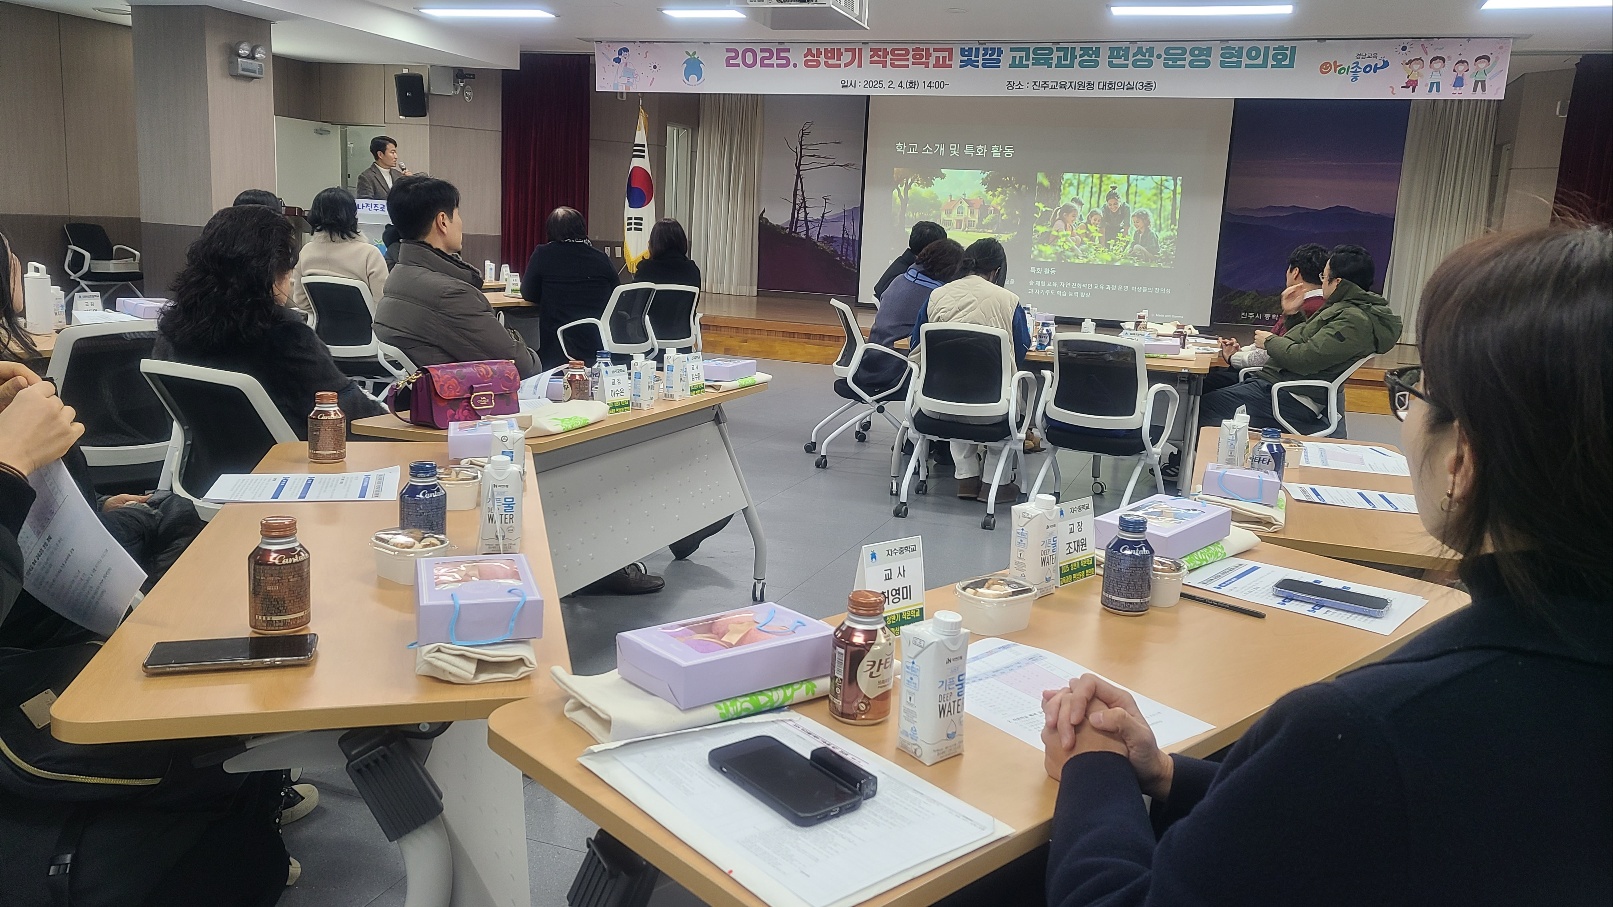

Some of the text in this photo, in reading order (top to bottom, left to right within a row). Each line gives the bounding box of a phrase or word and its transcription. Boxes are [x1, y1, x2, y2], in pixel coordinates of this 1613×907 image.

[725, 45, 1297, 69] 2025. 상반기 작은학교 빛깔 교육과정 편성·운영 협의회
[1319, 60, 1389, 82] 아이좋아
[840, 79, 857, 89] 일시
[863, 79, 885, 90] 2025.
[1006, 81, 1024, 90] 장소
[1031, 81, 1095, 91] 진주교육지원청
[895, 142, 1015, 158] 학교 소개 및 특화 활동
[1241, 312, 1262, 320] 진주시
[886, 544, 917, 557] 지수중학교
[1065, 537, 1087, 556] 조재원
[1041, 554, 1057, 568] WATE
[884, 565, 906, 581] 교 사
[938, 692, 952, 703] DEEP
[938, 698, 964, 719] WATE
